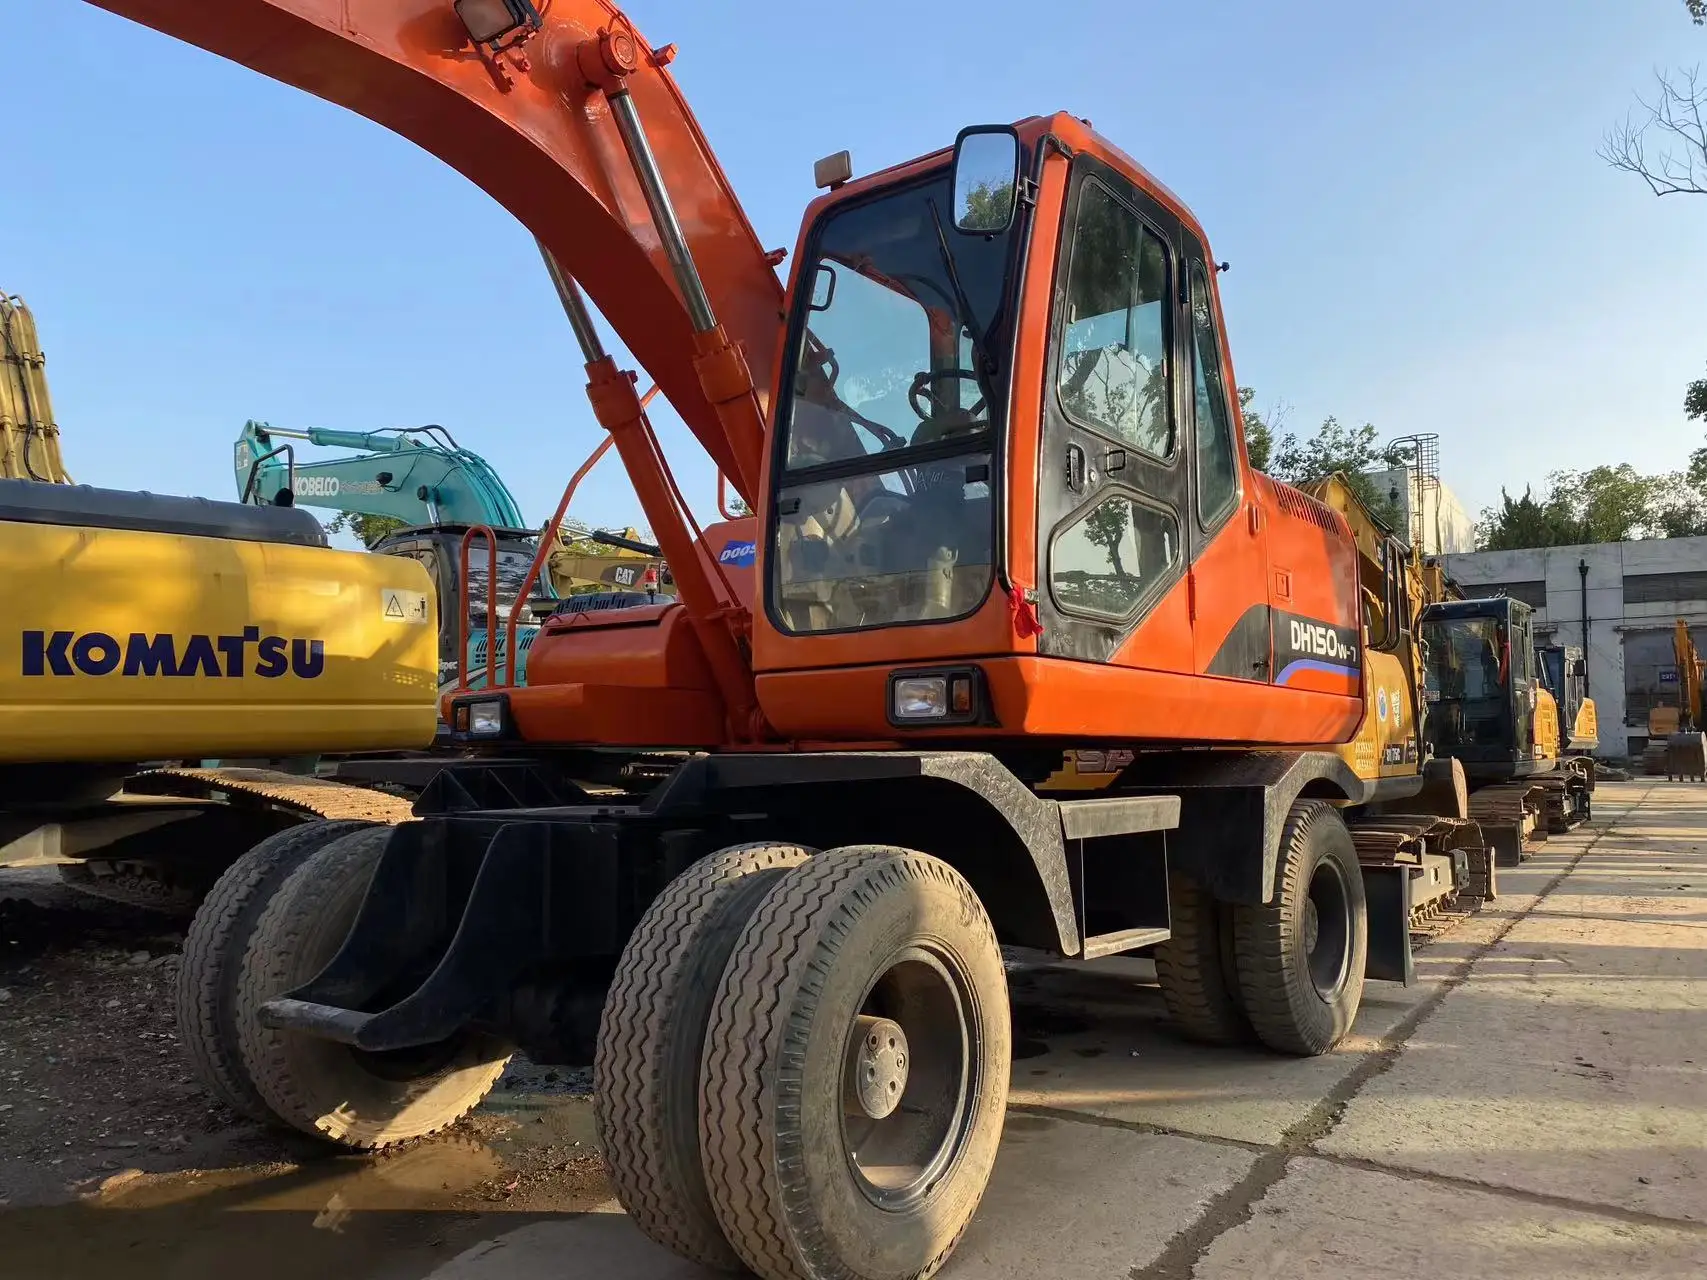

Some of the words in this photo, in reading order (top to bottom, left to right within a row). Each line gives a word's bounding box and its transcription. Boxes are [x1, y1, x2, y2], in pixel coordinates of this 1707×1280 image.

[294, 477, 340, 496] KOBELCO
[615, 566, 635, 585] CAT
[22, 626, 324, 678] KOMATSU
